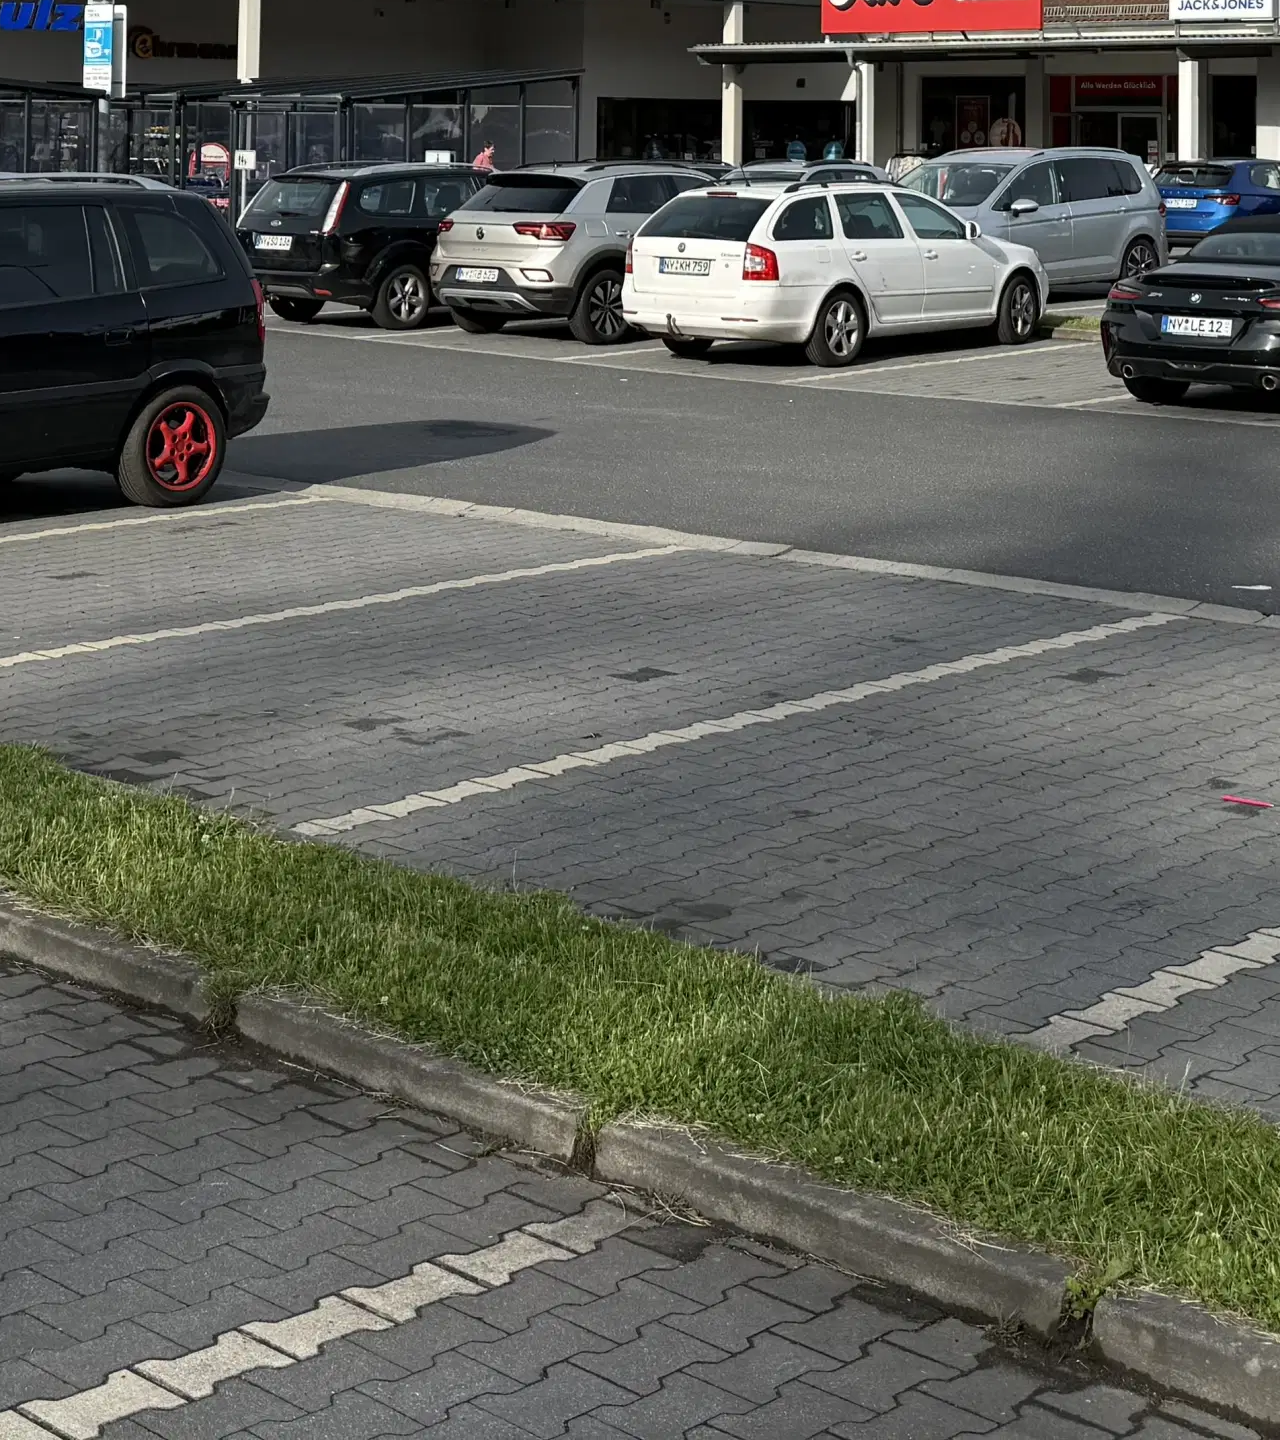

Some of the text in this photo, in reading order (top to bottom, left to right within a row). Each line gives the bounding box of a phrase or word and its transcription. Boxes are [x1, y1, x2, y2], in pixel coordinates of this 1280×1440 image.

[1123, 81, 1156, 89] Glücklich
[664, 260, 709, 272] NY KH 759
[1168, 318, 1184, 330] NY
[1191, 319, 1206, 332] LE
[1208, 320, 1223, 333] 12
